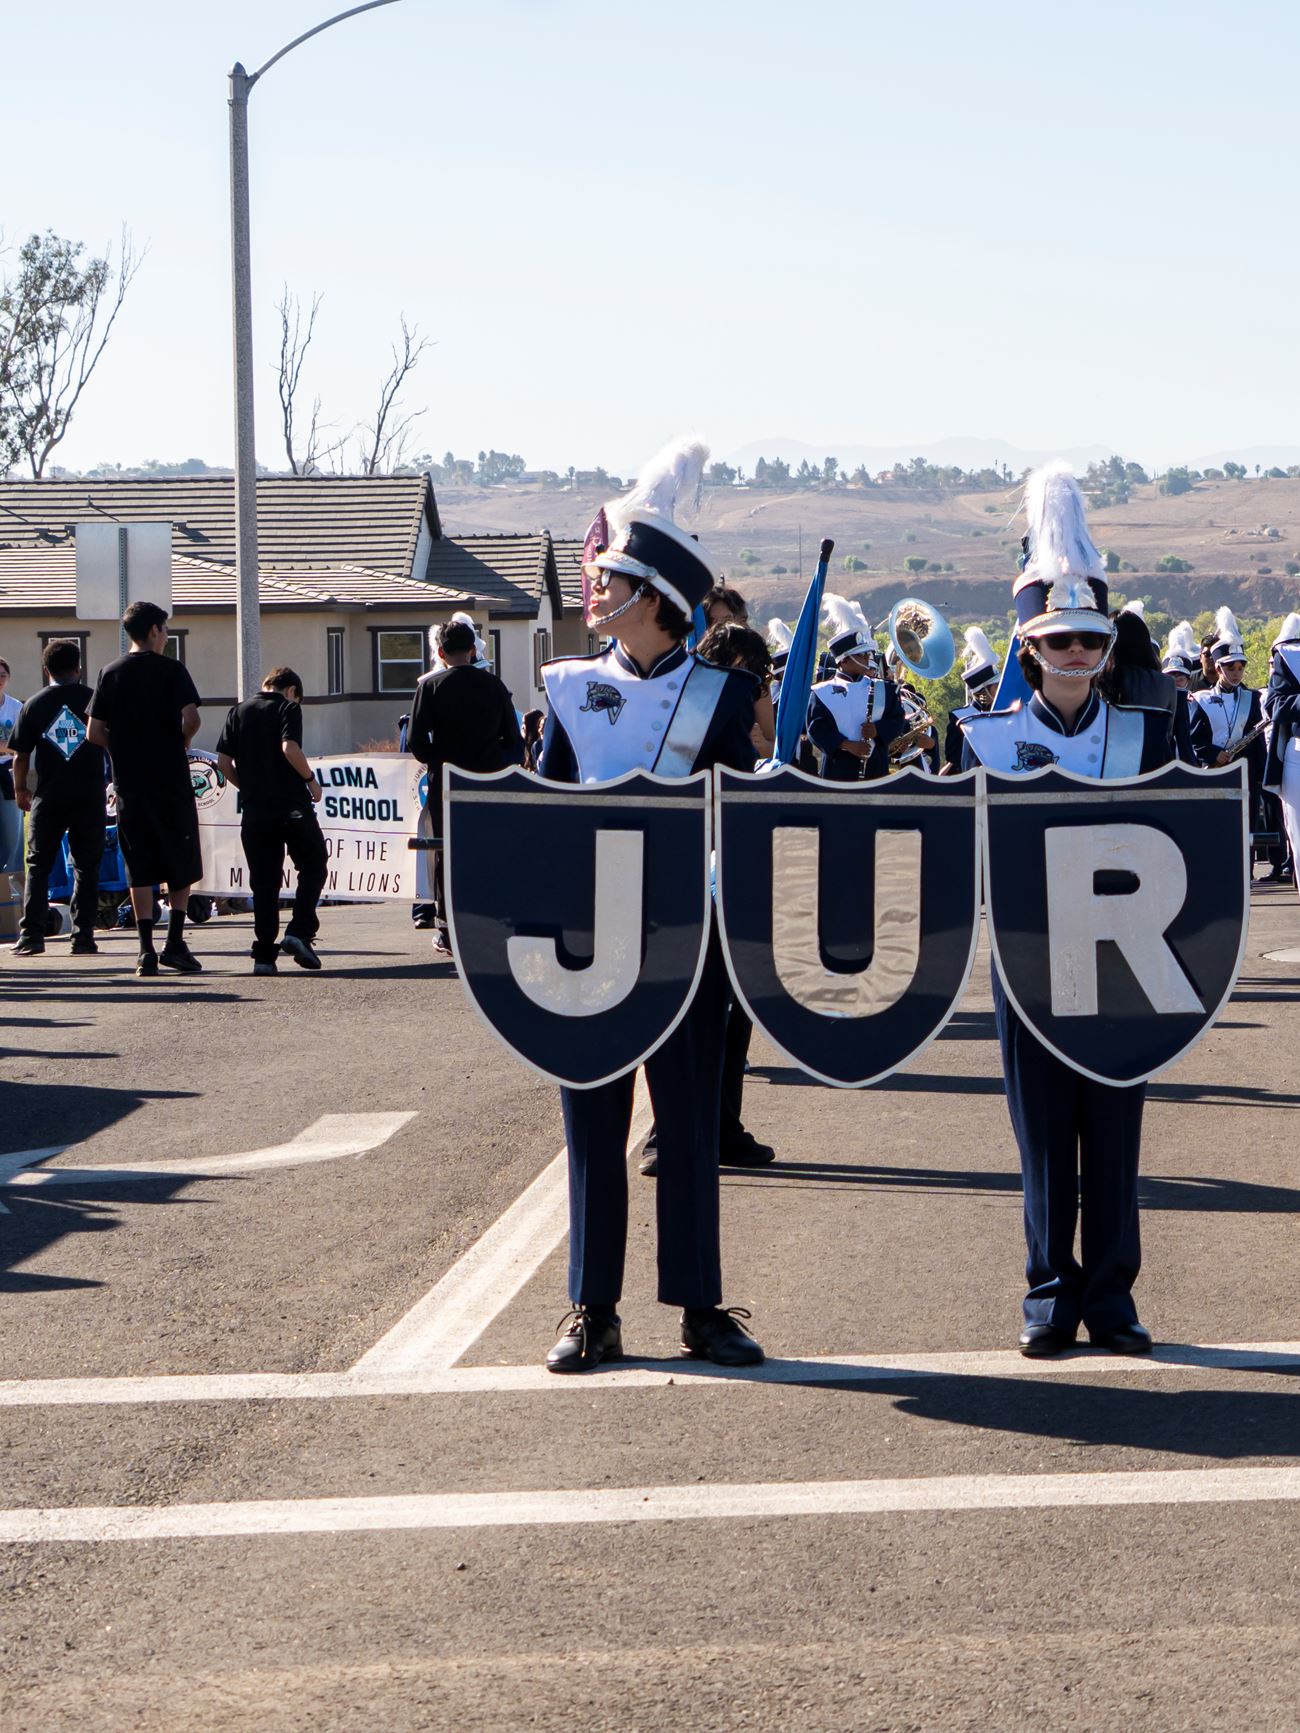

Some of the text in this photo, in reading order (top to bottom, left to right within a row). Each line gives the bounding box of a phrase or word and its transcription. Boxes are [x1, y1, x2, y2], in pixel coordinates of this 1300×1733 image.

[56, 728, 78, 738] AVID
[316, 766, 379, 789] LOMA
[325, 796, 404, 822] SCHOOL
[325, 838, 388, 861] OF THE
[349, 872, 401, 894] LIONS
